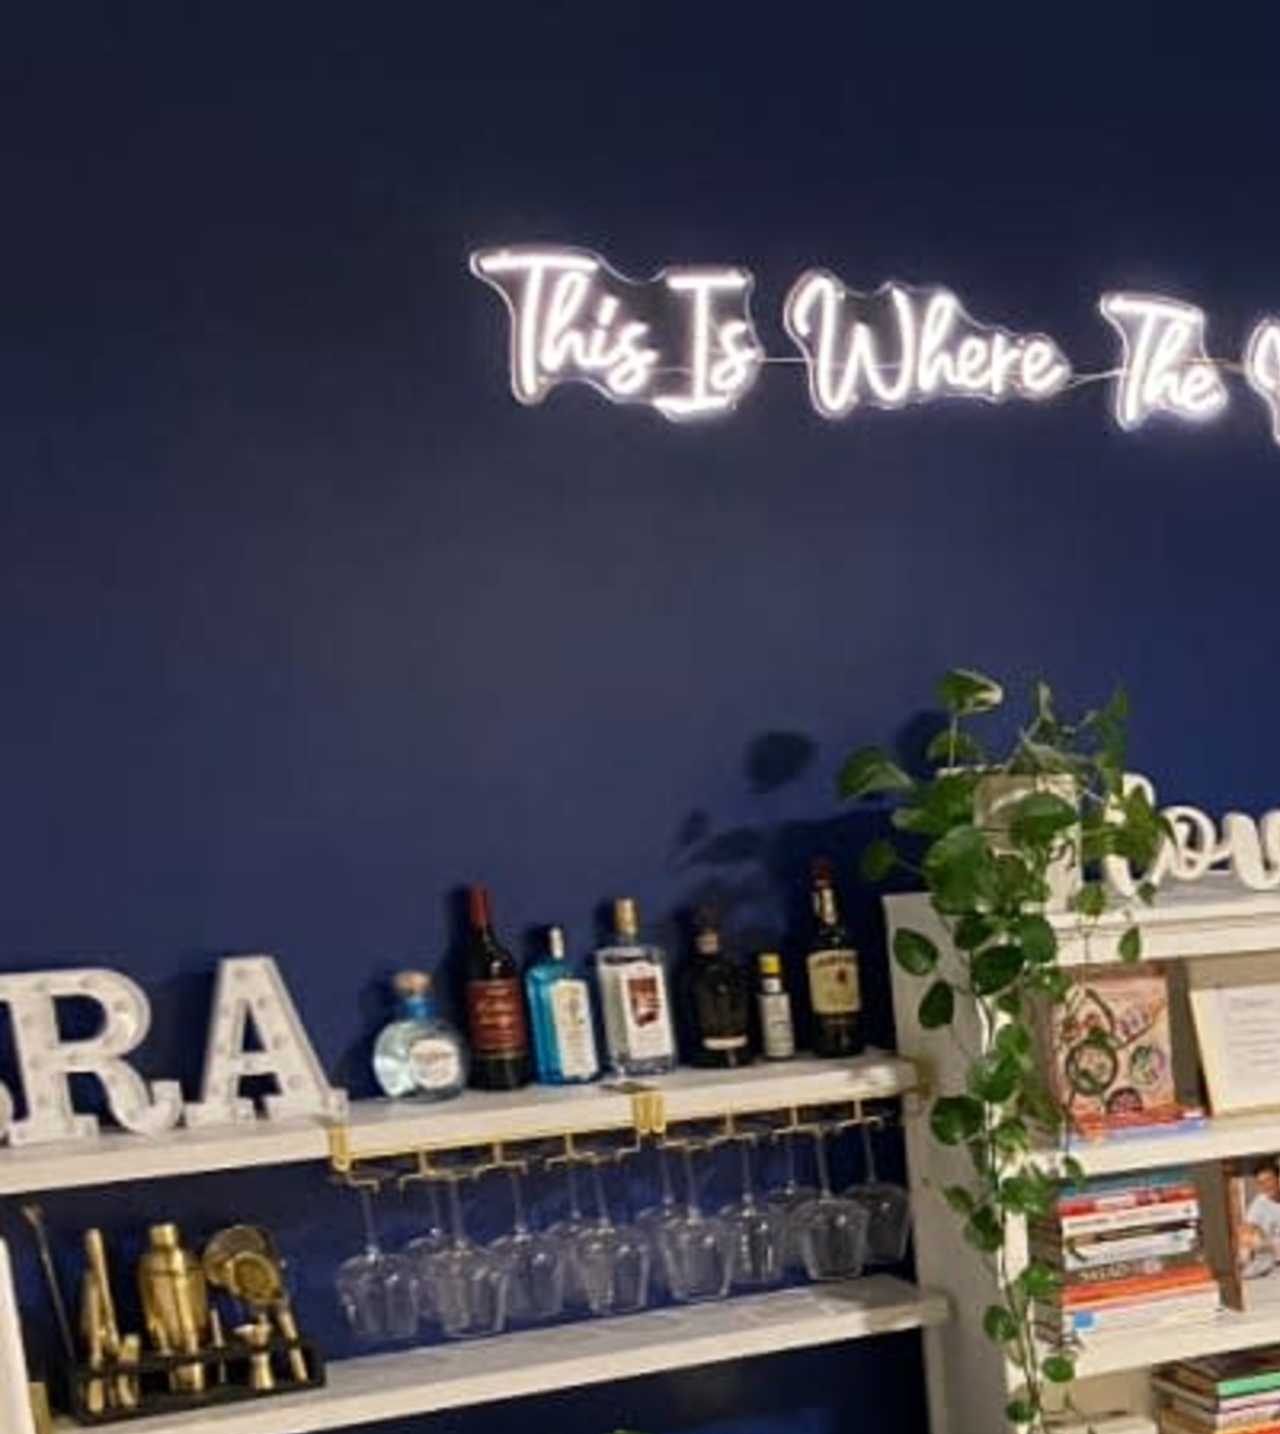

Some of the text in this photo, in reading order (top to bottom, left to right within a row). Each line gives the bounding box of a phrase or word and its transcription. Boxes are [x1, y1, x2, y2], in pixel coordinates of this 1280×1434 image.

[480, 253, 660, 397] This
[656, 274, 761, 412] Is
[793, 274, 1070, 412] Where
[1107, 296, 1228, 424] The
